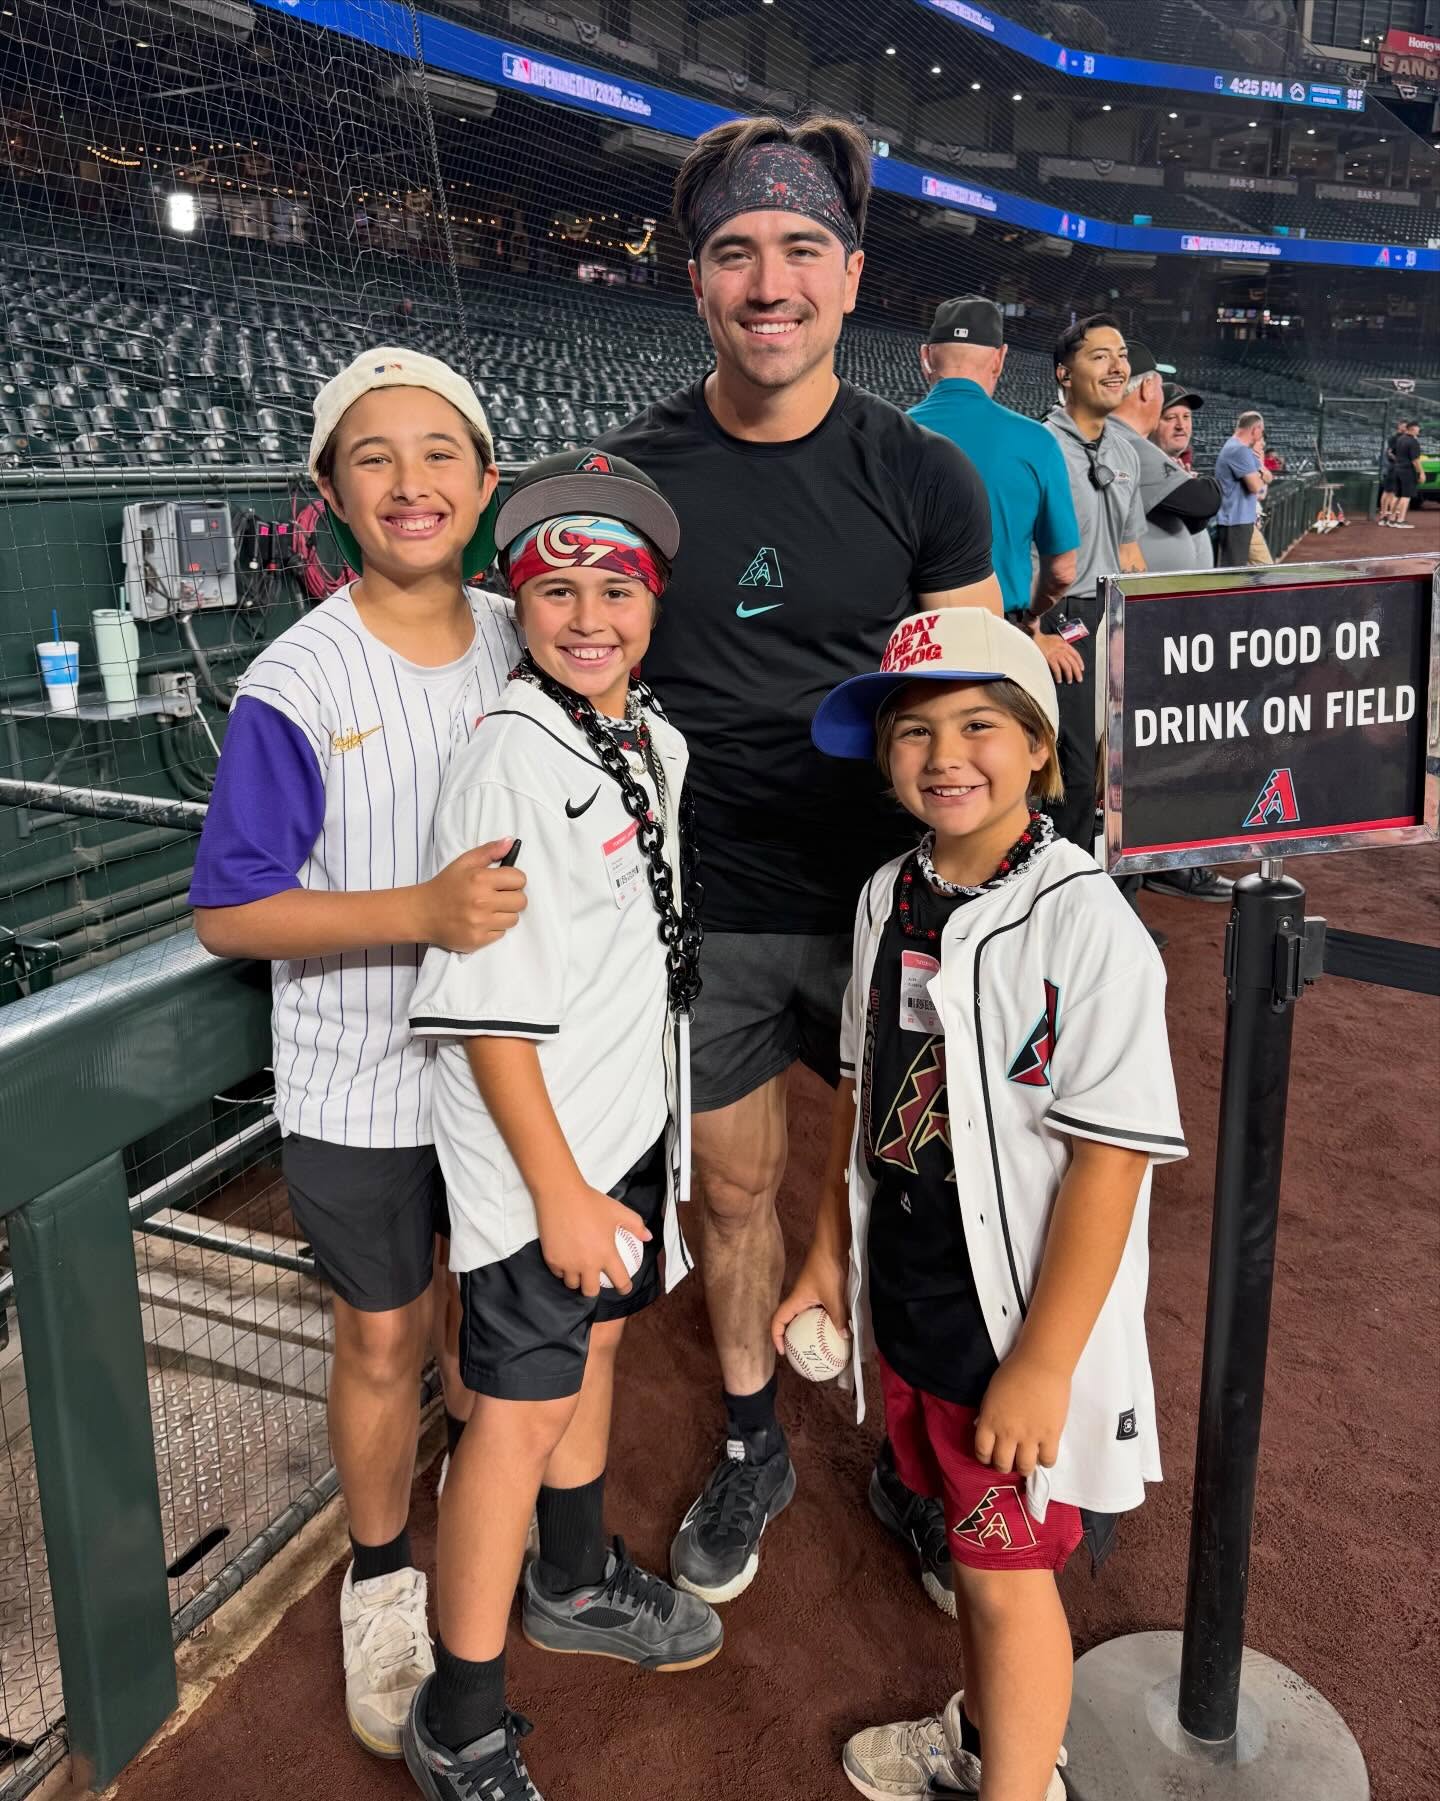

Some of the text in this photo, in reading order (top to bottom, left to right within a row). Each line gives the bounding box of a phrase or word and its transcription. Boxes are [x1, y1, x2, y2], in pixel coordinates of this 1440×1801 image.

[1229, 77, 1260, 95] 4:25
[1261, 80, 1283, 98] PM
[900, 615, 941, 641] DAY
[894, 637, 914, 660] BE
[915, 630, 932, 649] A
[898, 644, 943, 672] DOG
[1163, 620, 1381, 675] NO FOOD OR
[1134, 684, 1416, 747] DRINK ON FIELD
